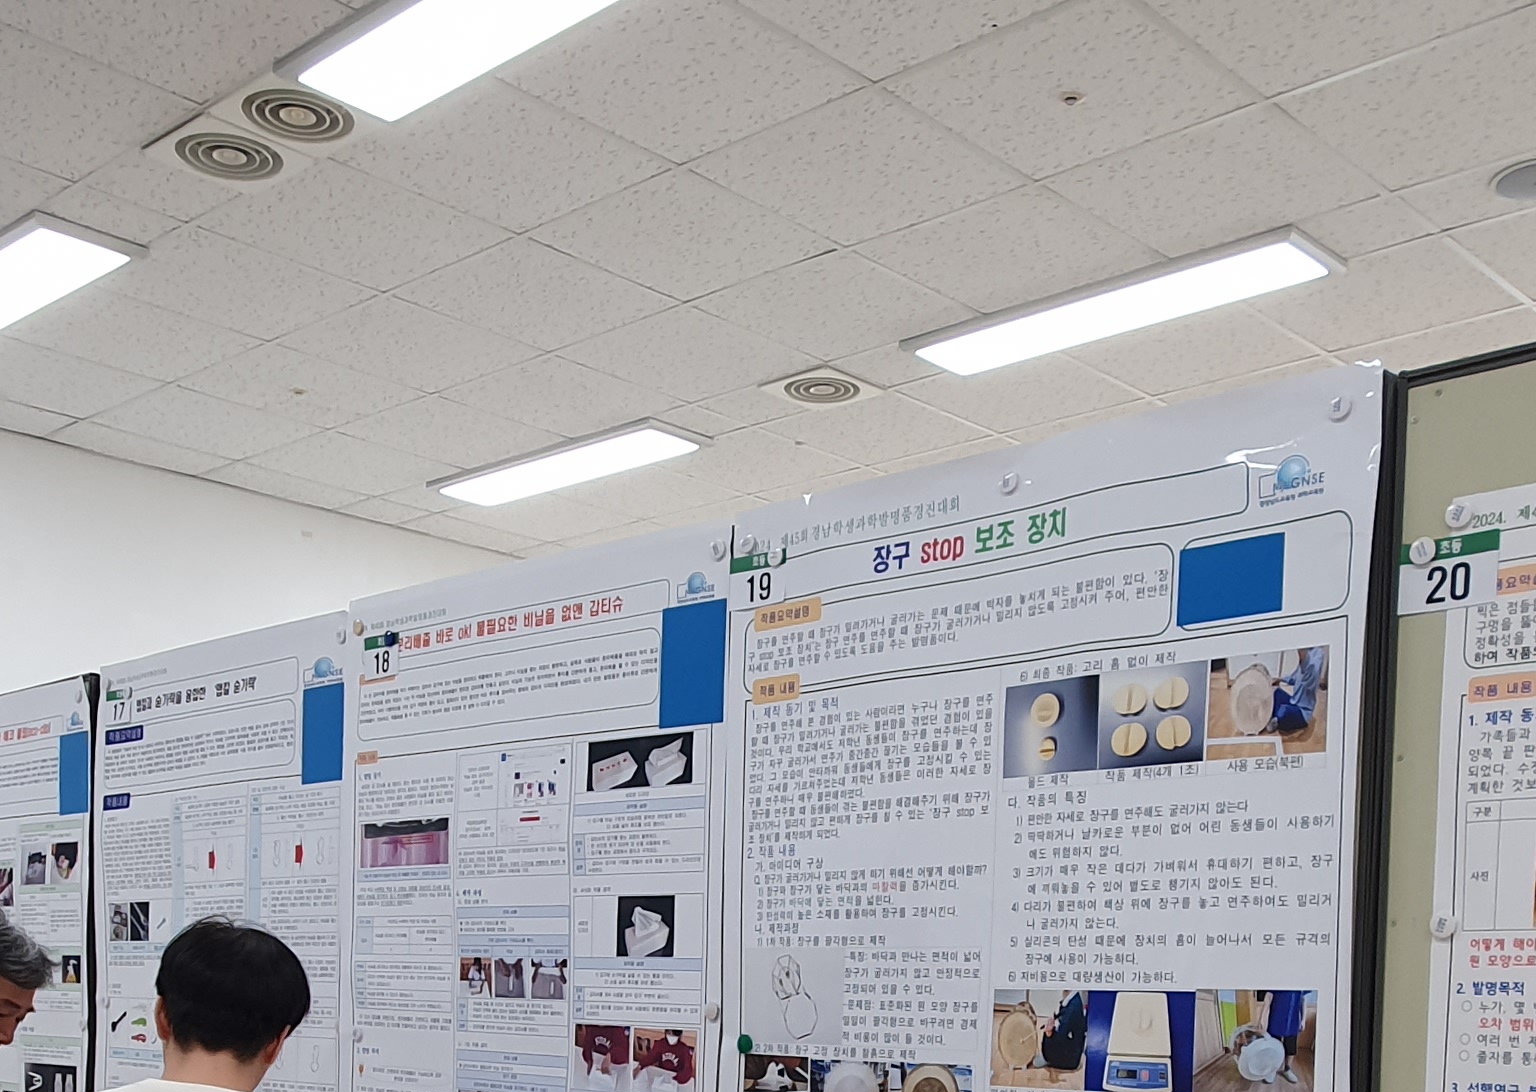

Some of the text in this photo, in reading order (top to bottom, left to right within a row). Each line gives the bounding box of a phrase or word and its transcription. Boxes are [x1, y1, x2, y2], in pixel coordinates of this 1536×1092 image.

[1469, 511, 1507, 534] 2024.
[872, 507, 1068, 574] 장구 stop 보조 장치
[1438, 539, 1463, 555] 초등
[746, 571, 772, 603] 19
[1425, 561, 1472, 605] 20
[1476, 626, 1530, 650] 정확성을
[373, 650, 390, 675] 18
[1474, 647, 1498, 665] 하여
[1473, 680, 1532, 698] 작품 내용
[113, 702, 126, 722] 17
[1468, 714, 1478, 727] 1.
[1485, 709, 1513, 726] 제작
[1007, 790, 1087, 809] 다. 작품의 특징
[1056, 810, 1085, 824] 자세로
[1089, 808, 1119, 822] 장구를
[1124, 805, 1164, 820] 연주해도
[1168, 802, 1210, 818] 굴러가지
[1215, 799, 1249, 815] 않는다
[1471, 938, 1505, 953] 어떻게
[1469, 955, 1480, 968] 원
[1072, 970, 1125, 984] 대량생산이
[1131, 970, 1177, 984] 가능하다.
[1472, 981, 1525, 997] 발명목적
[1513, 1000, 1526, 1015] 몇
[1479, 1018, 1502, 1030] 오차
